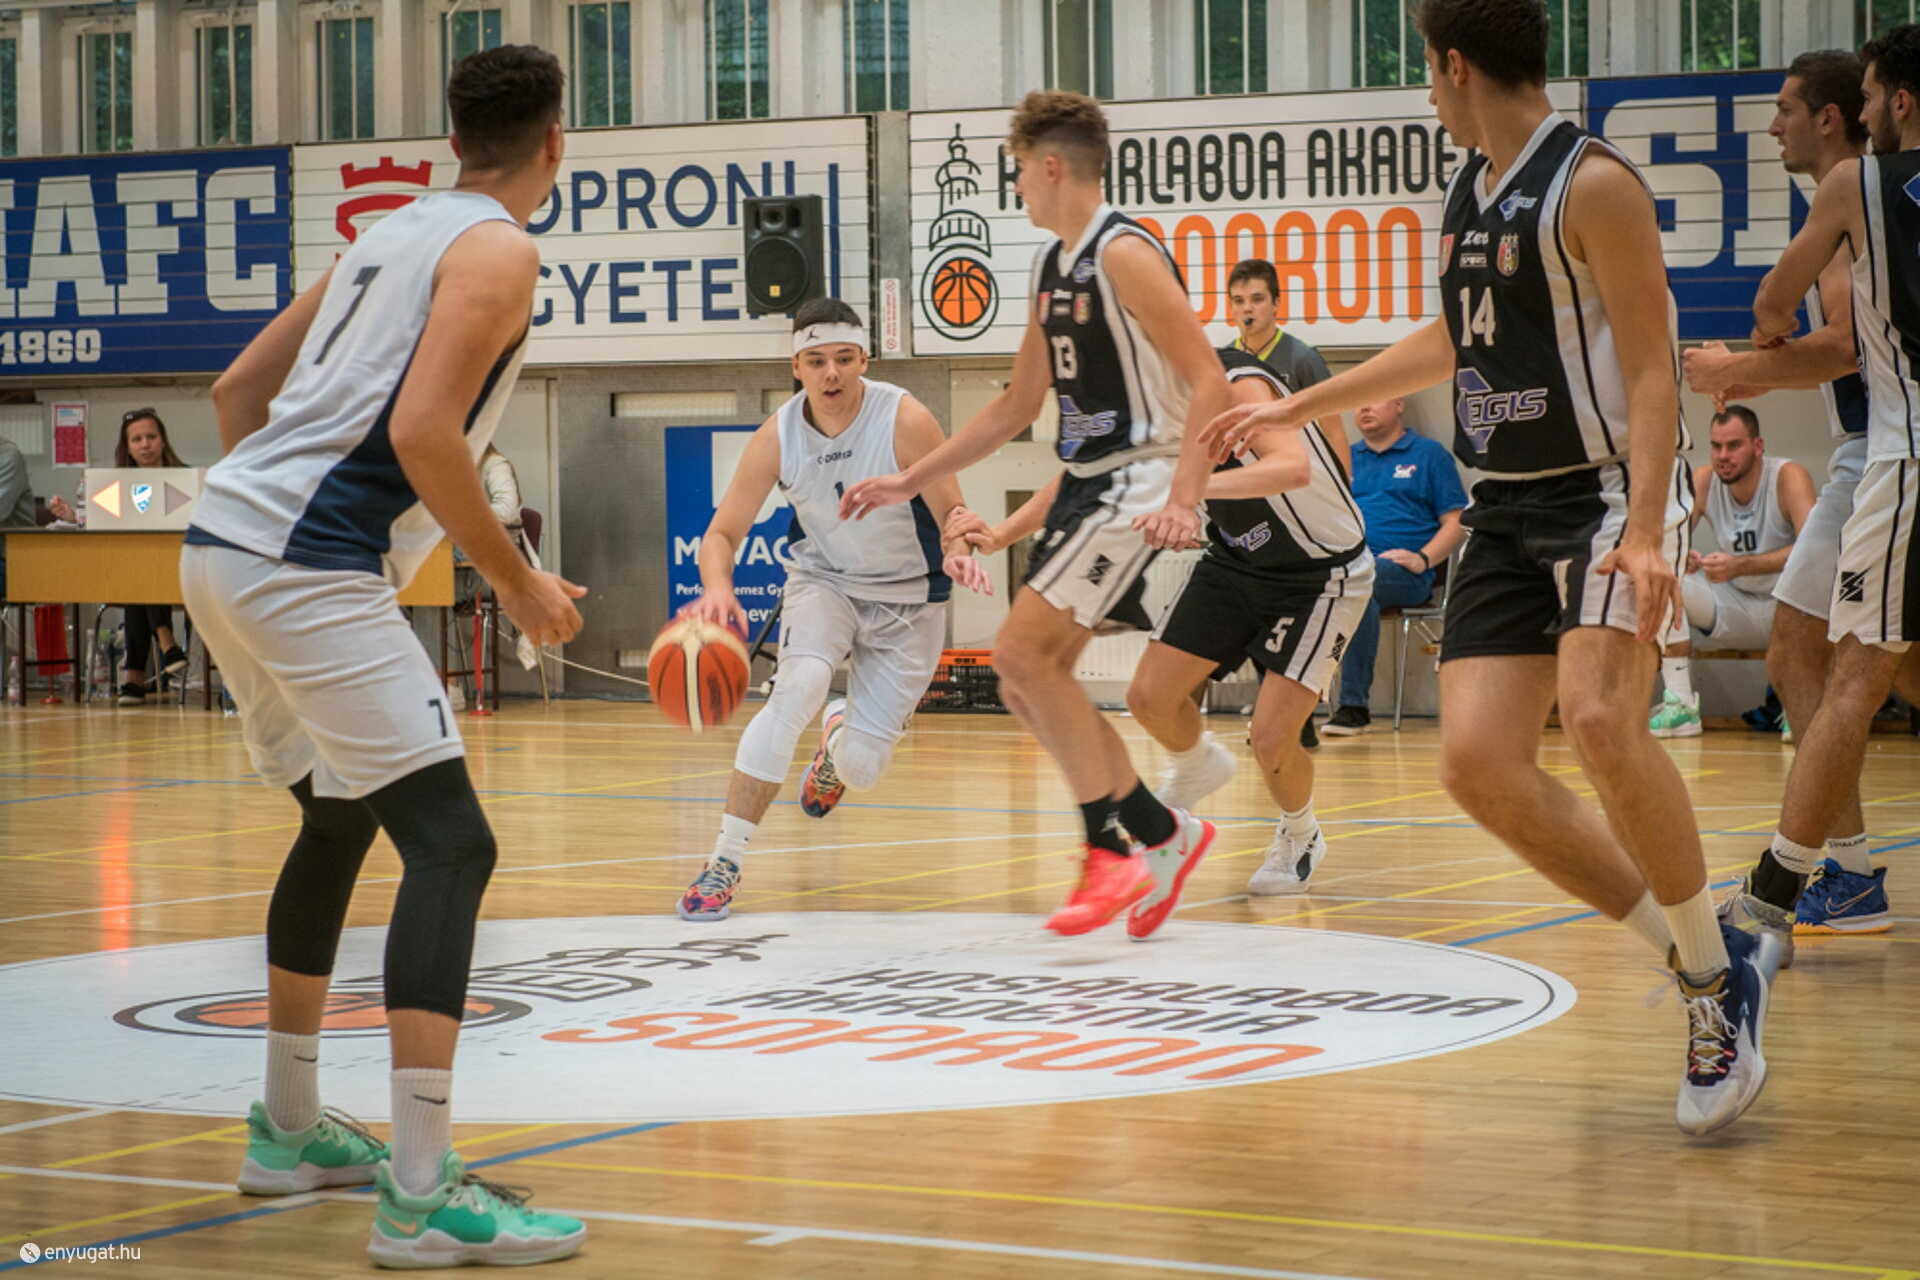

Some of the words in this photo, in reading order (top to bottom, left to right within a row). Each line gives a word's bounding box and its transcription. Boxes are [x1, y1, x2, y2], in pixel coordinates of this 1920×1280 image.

[526, 161, 795, 234] OPRONI
[998, 131, 1286, 210] KRLABDA
[1308, 124, 1476, 197] AKADE
[0, 166, 277, 318] AFC
[1136, 207, 1423, 327] OPRON
[313, 265, 384, 365] 7
[532, 259, 797, 326] GYETE
[1459, 287, 1496, 346] 14
[0, 329, 101, 364] 1860
[1050, 336, 1078, 380] 13
[1733, 530, 1757, 552] 20
[1265, 617, 1295, 653] 5
[427, 698, 447, 738] 7
[541, 1012, 1324, 1079] SOPRON
